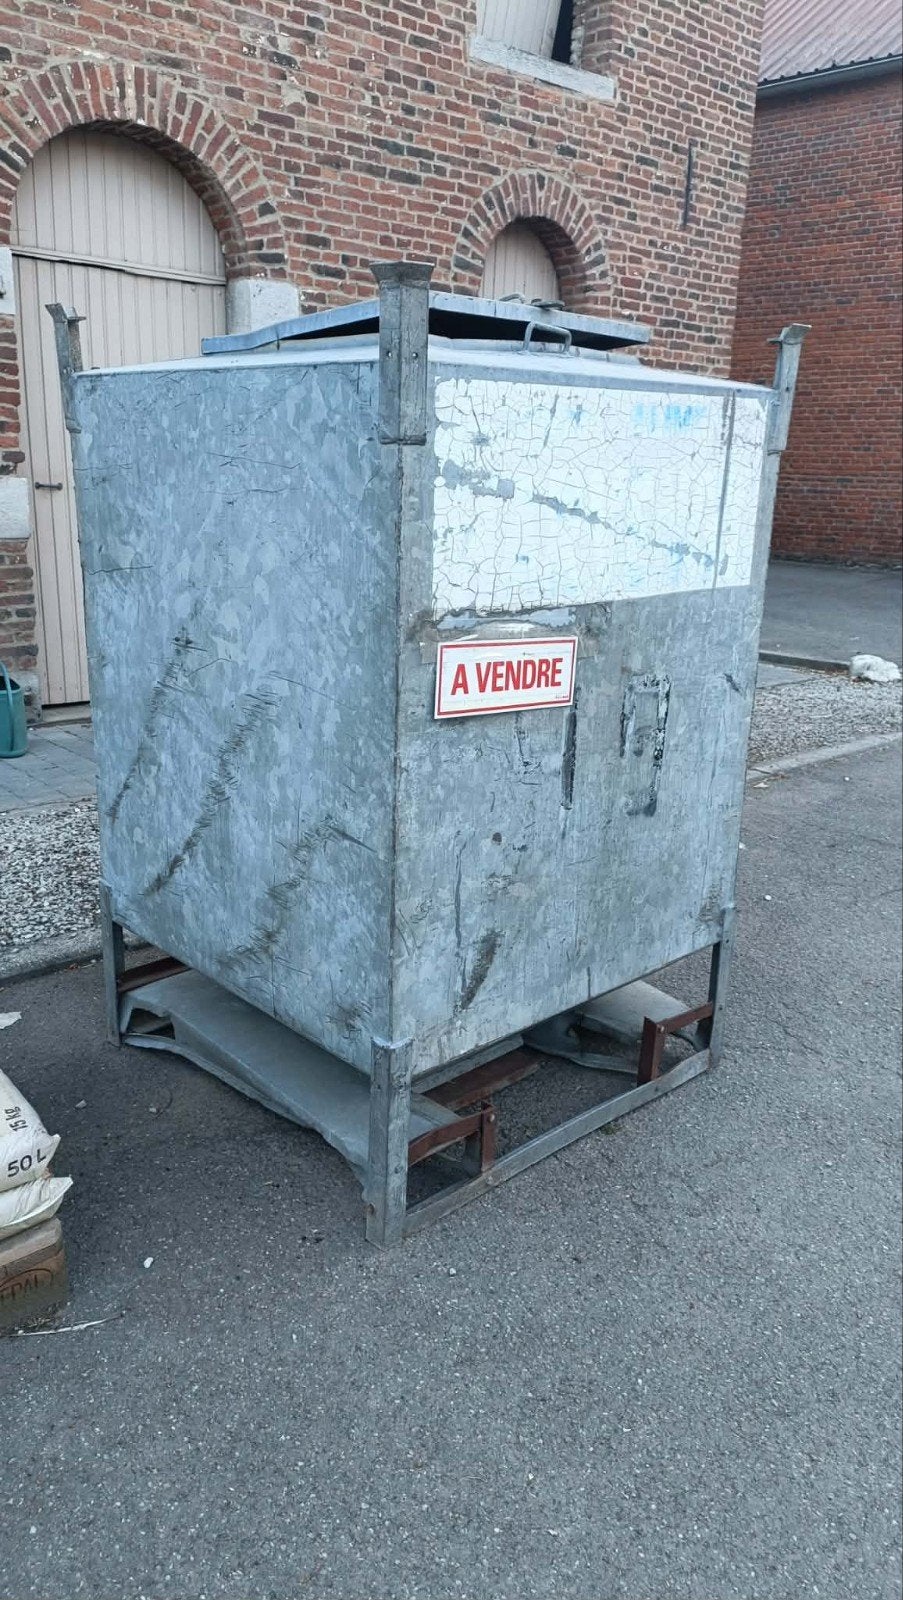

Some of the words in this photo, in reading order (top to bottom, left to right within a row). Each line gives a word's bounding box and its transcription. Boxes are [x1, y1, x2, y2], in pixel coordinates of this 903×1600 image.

[450, 664, 469, 696] A
[476, 657, 564, 694] VENDRE
[8, 1154, 32, 1177] 50
[37, 1148, 47, 1163] L
